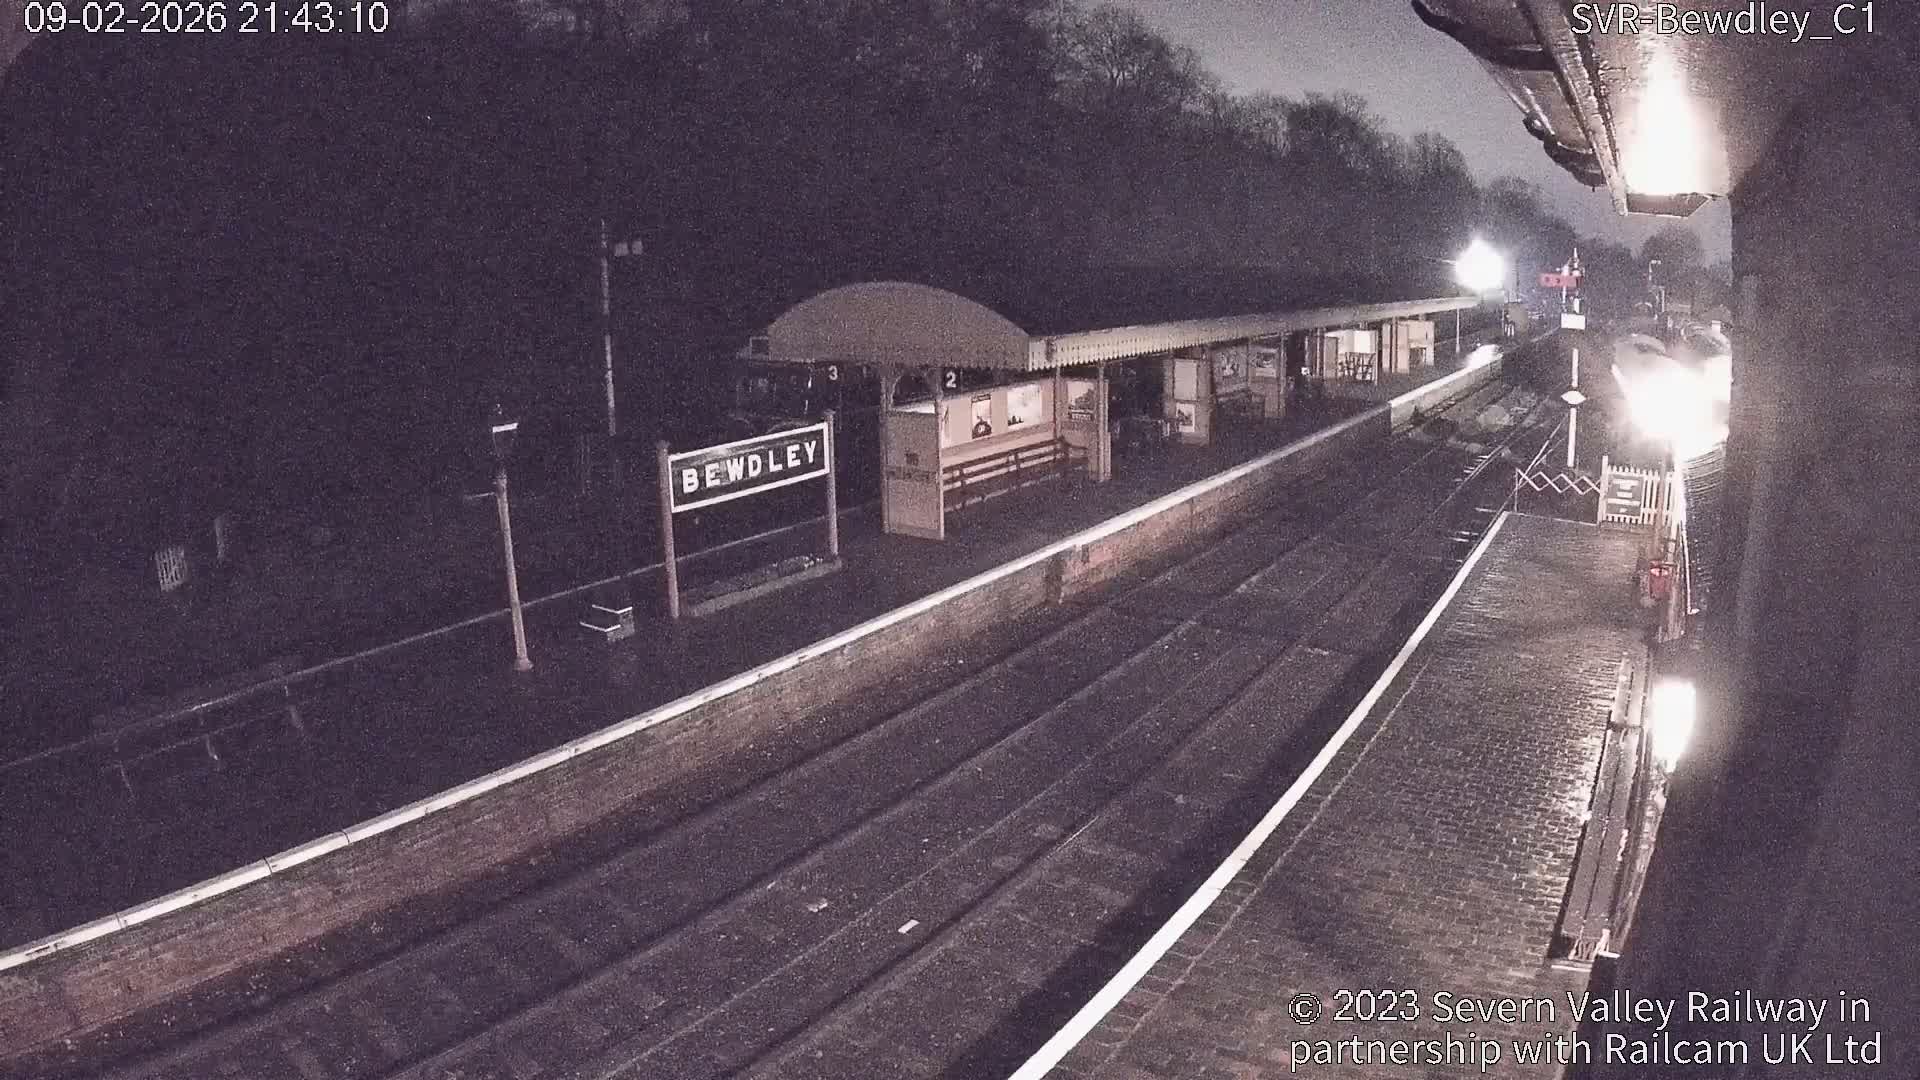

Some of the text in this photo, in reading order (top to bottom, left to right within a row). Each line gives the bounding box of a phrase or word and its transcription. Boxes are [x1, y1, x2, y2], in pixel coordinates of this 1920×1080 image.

[828, 365, 838, 381] 3
[946, 370, 957, 388] 2
[682, 440, 817, 494] BEWDLEY
